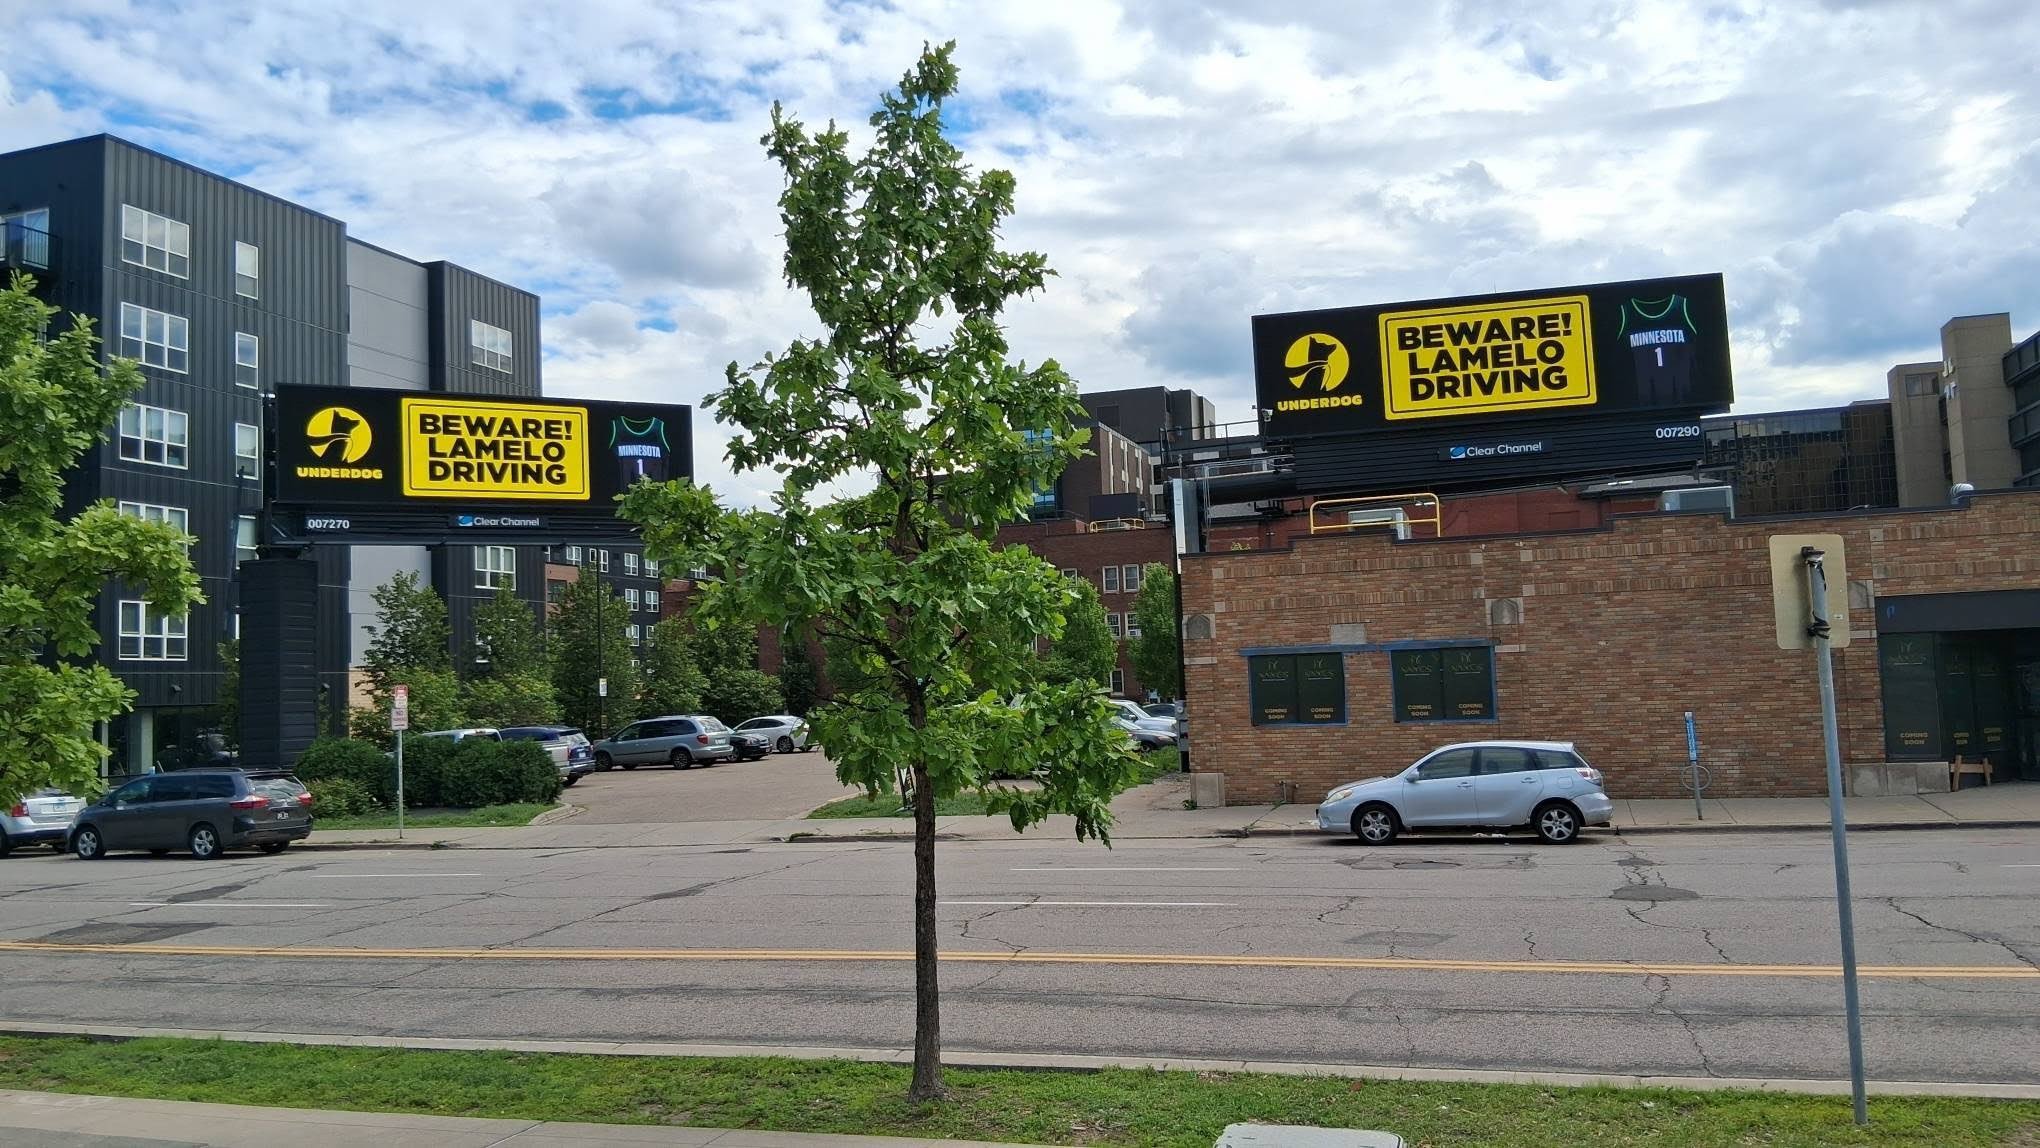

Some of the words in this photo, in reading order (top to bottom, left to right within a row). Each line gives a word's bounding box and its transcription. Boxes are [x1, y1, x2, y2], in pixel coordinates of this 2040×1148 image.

[1398, 312, 1571, 350] BEWARE!
[1630, 329, 1685, 347] MINNESOTA
[1408, 340, 1565, 375] LAMELO
[1654, 347, 1664, 367] 1
[1410, 365, 1568, 402] DRIVING
[1277, 394, 1363, 412] UNDERDOG
[420, 413, 573, 441] BEWARE!
[1655, 425, 1700, 438] 007290
[429, 437, 566, 463] LAMELO
[618, 445, 661, 458] MINNESOTA
[1467, 446, 1495, 457] Clear
[1497, 441, 1542, 454] Channel
[297, 466, 383, 480] UNDERDOG
[429, 461, 567, 485] DRIVING
[637, 458, 644, 475] 1
[307, 518, 350, 529] 007270
[473, 516, 499, 526] Clear
[501, 517, 540, 527] Channel
